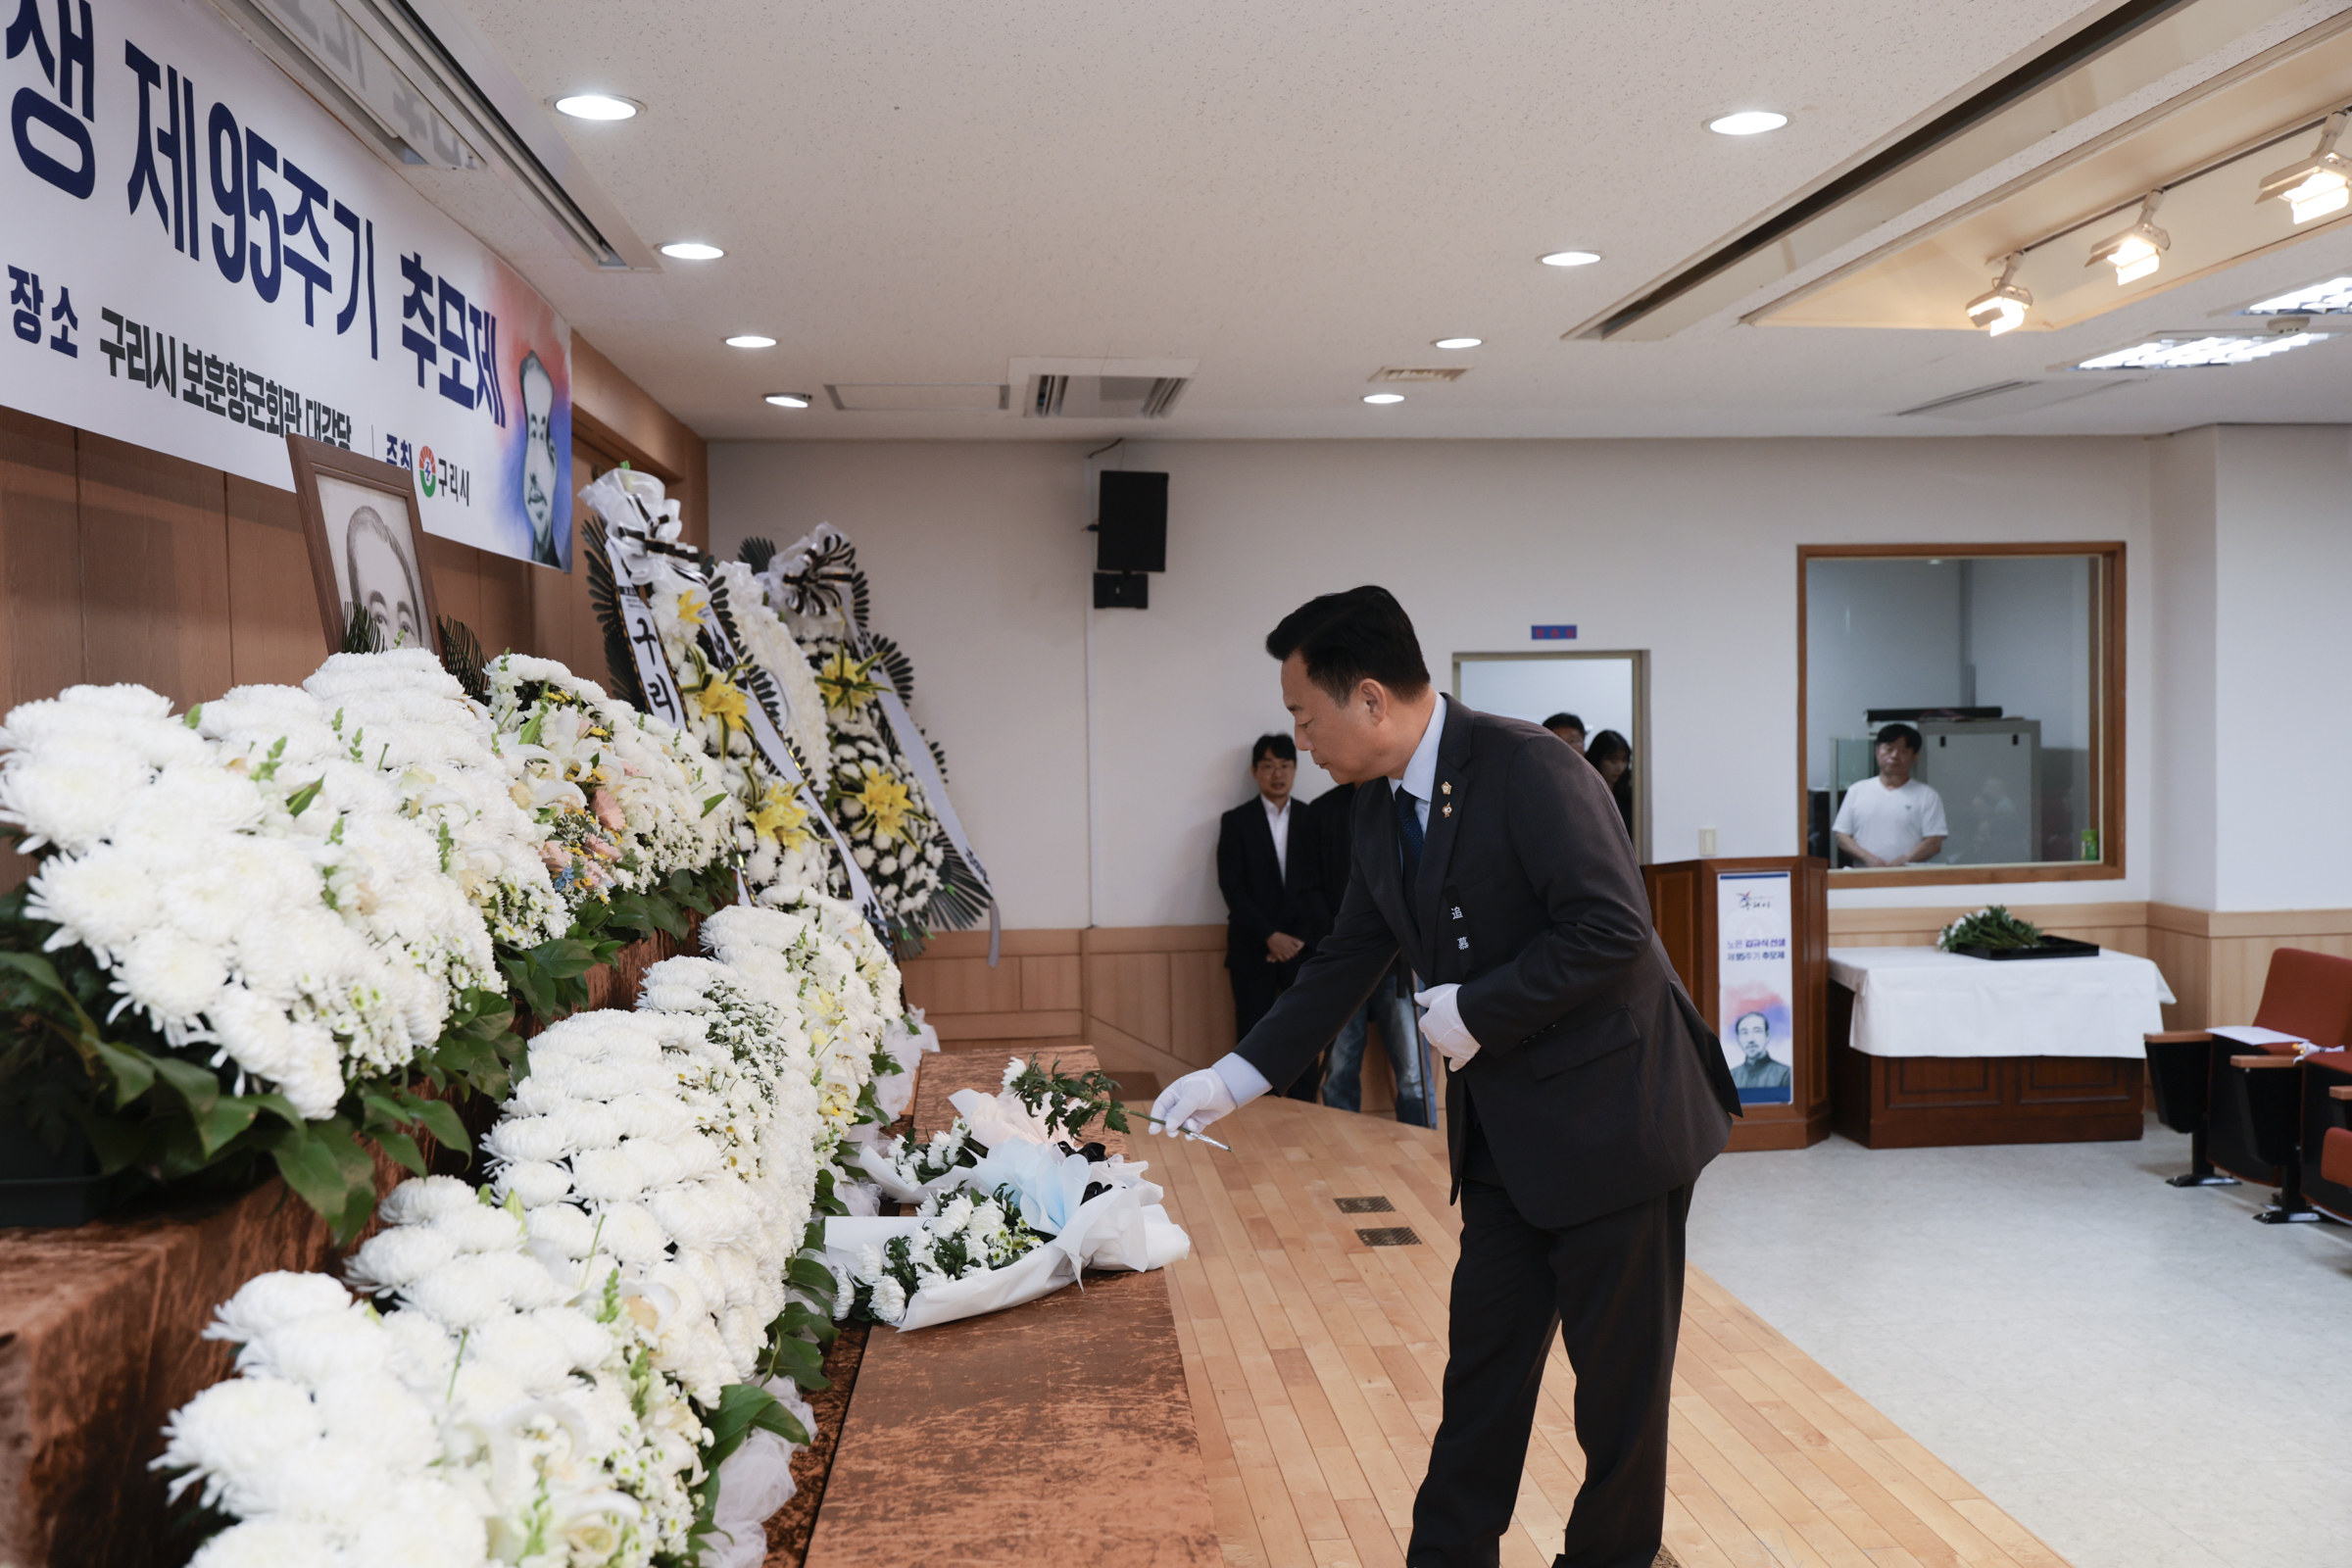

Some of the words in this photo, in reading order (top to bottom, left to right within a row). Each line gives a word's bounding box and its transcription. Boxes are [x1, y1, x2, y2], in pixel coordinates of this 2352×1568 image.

[99, 306, 176, 398] 구리시
[400, 251, 506, 428] 추모제
[438, 458, 469, 507] 구리시
